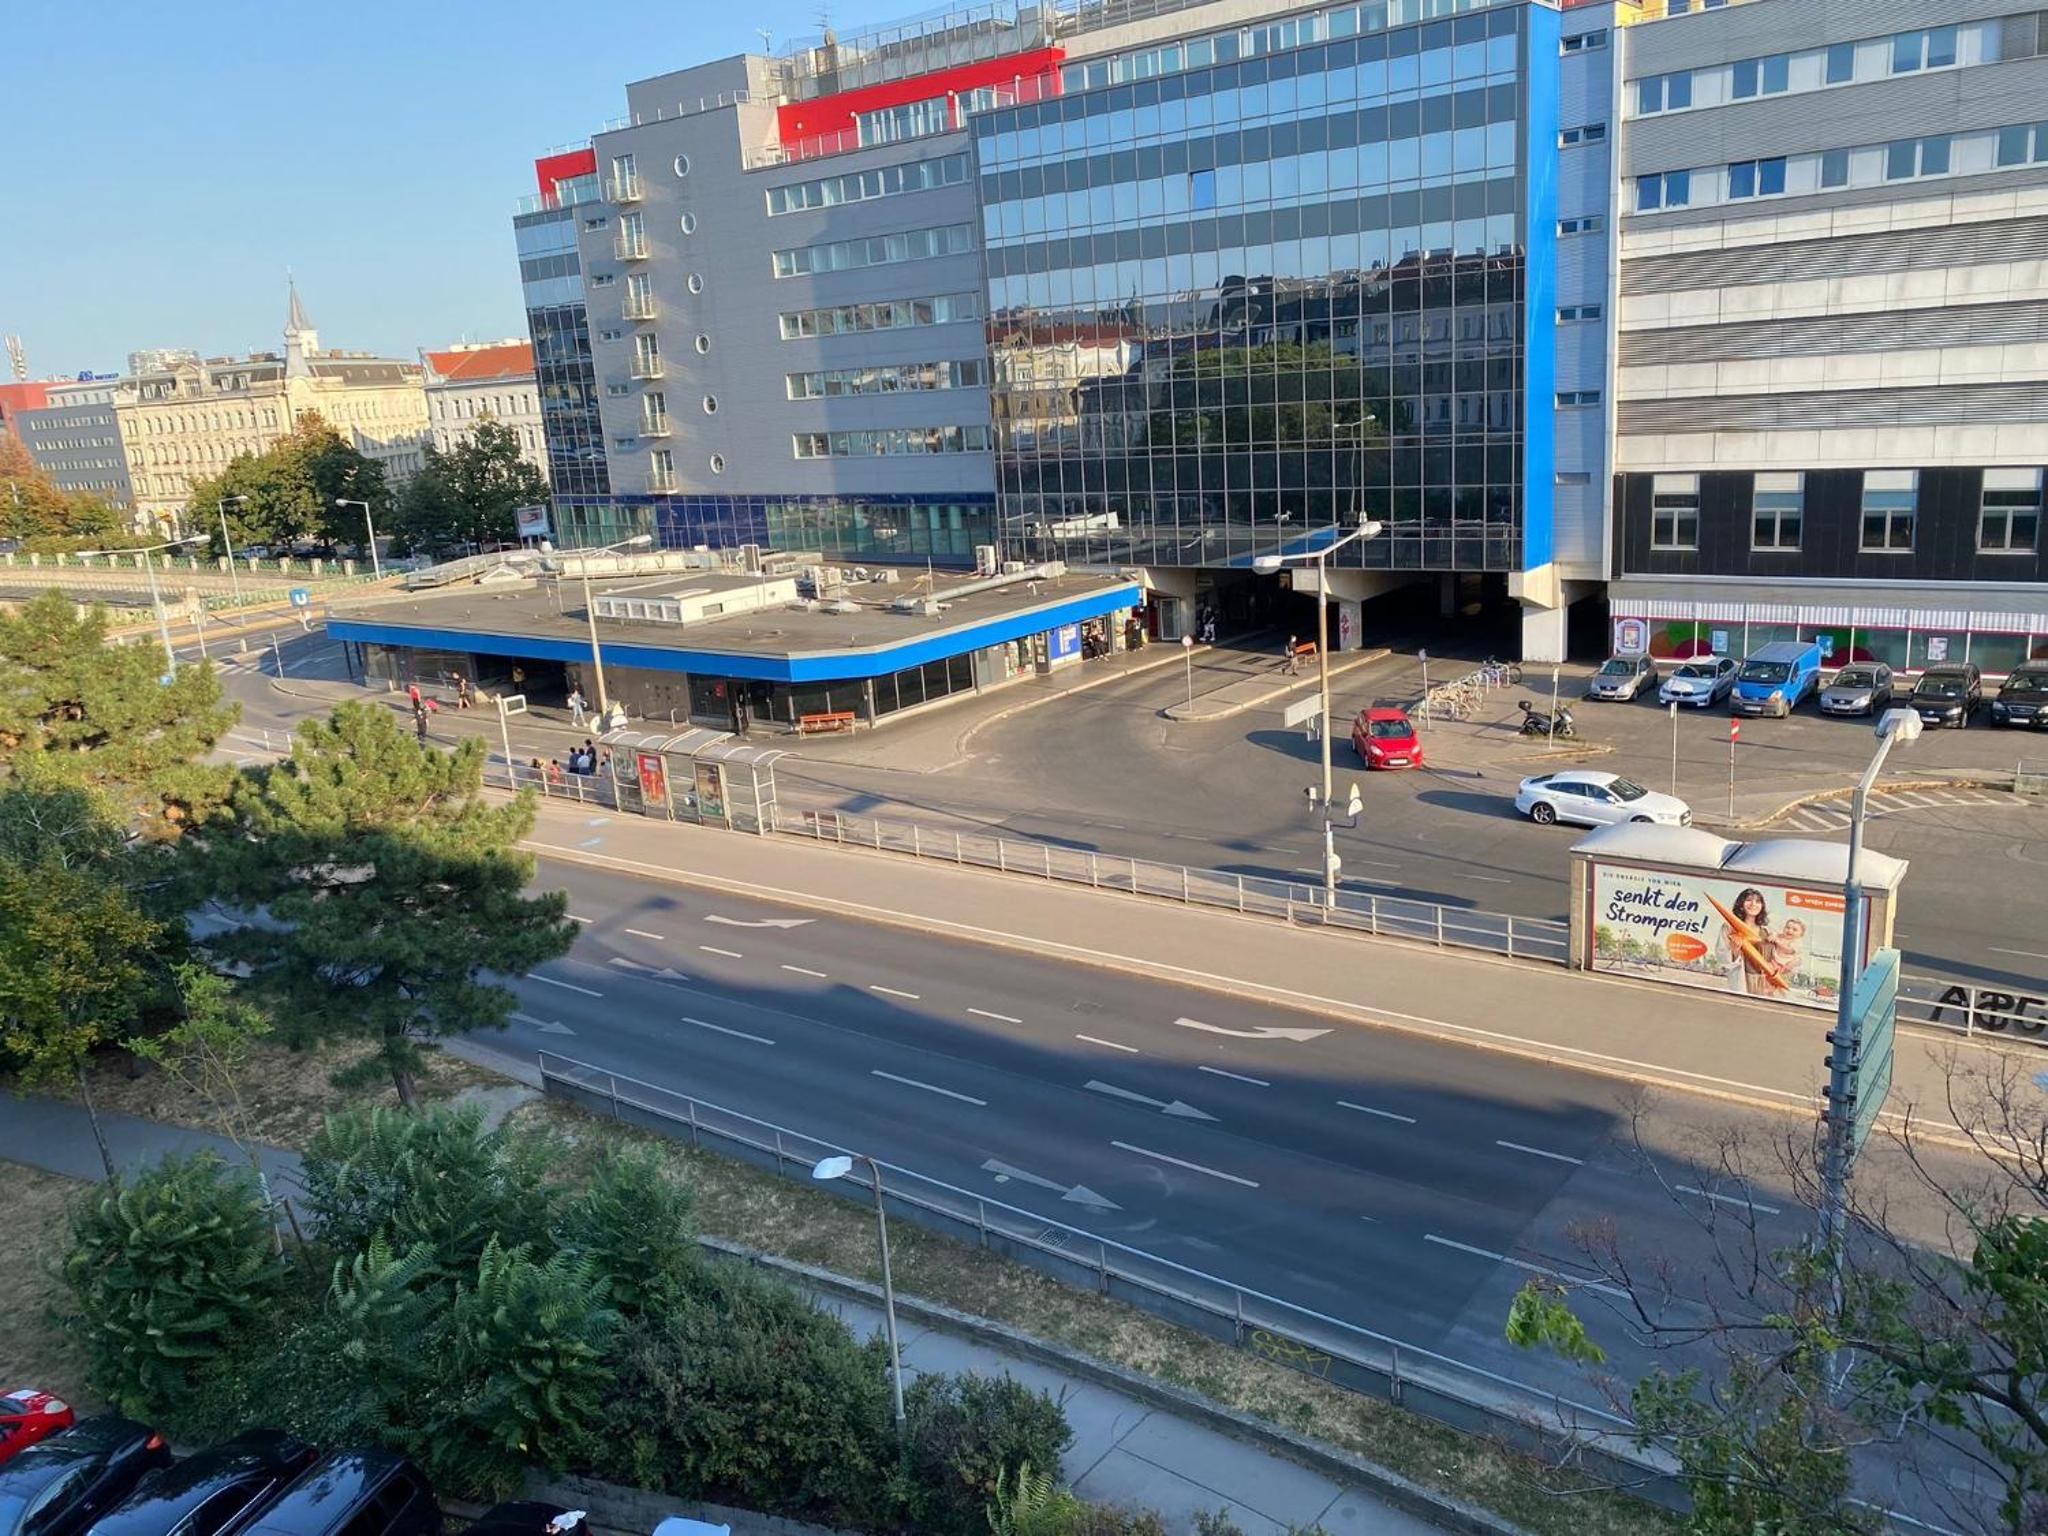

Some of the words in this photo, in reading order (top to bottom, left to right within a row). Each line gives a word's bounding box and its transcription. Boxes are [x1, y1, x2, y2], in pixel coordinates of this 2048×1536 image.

[1613, 886, 1665, 908] senkt
[1664, 892, 1699, 912] den
[1606, 902, 1709, 937] Strompreis!
